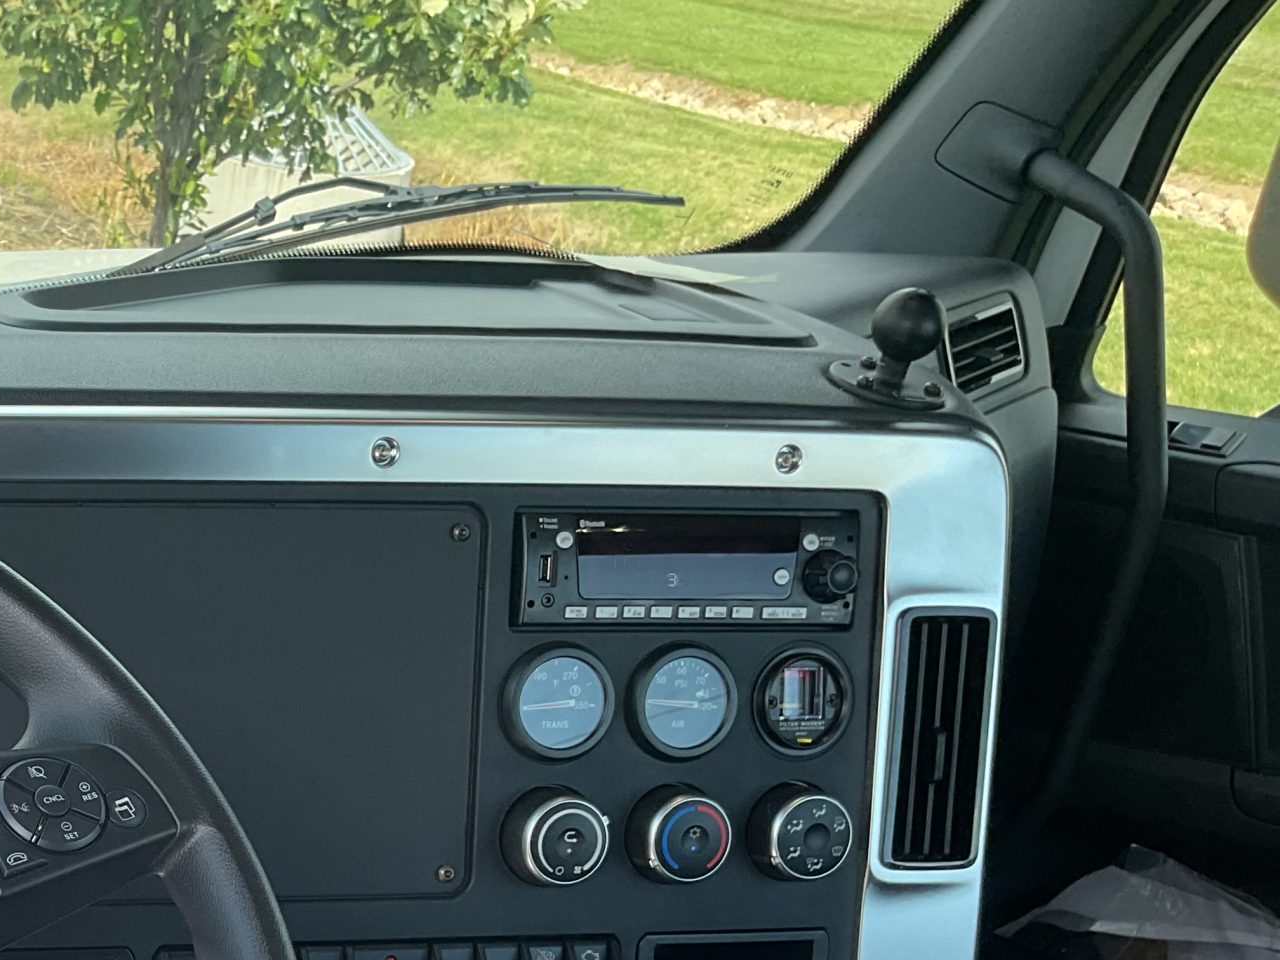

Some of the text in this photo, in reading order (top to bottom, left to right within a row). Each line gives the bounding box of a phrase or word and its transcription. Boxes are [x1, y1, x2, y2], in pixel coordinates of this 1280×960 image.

[542, 720, 569, 729] TRANS
[43, 794, 65, 804] CNCL
[82, 792, 98, 802] RES
[64, 831, 79, 840] SET
